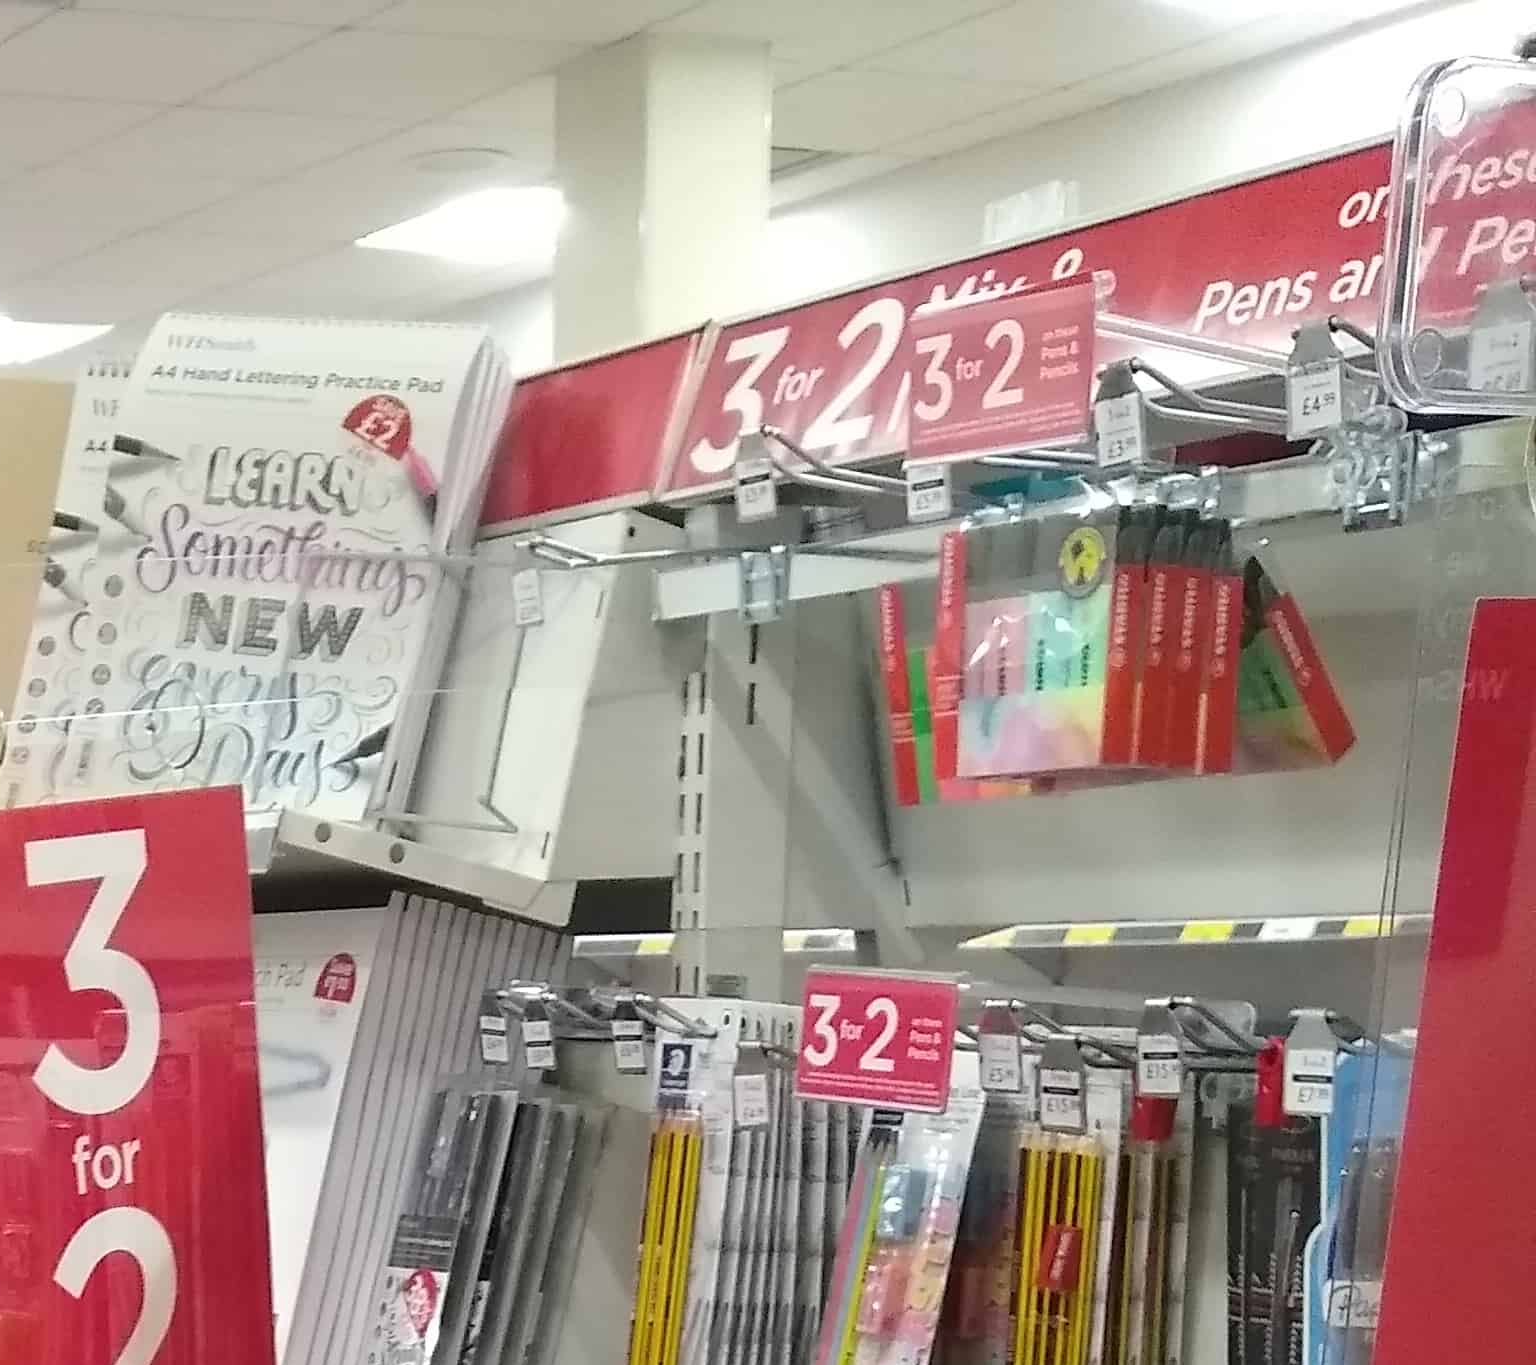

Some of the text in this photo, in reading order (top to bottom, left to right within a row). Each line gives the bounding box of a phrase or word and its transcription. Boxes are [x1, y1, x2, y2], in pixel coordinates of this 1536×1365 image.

[1193, 270, 1318, 333] Pens
[183, 368, 229, 382] Hand
[236, 368, 318, 389] Lettering
[324, 372, 401, 391] Practice
[407, 377, 444, 393] Pad
[689, 298, 905, 474] 3 for 2
[914, 320, 1025, 420] 3 for 2
[177, 591, 363, 664] NEW
[24, 828, 162, 1116] 3
[805, 995, 899, 1073] 3 for 2
[72, 1134, 142, 1195] for
